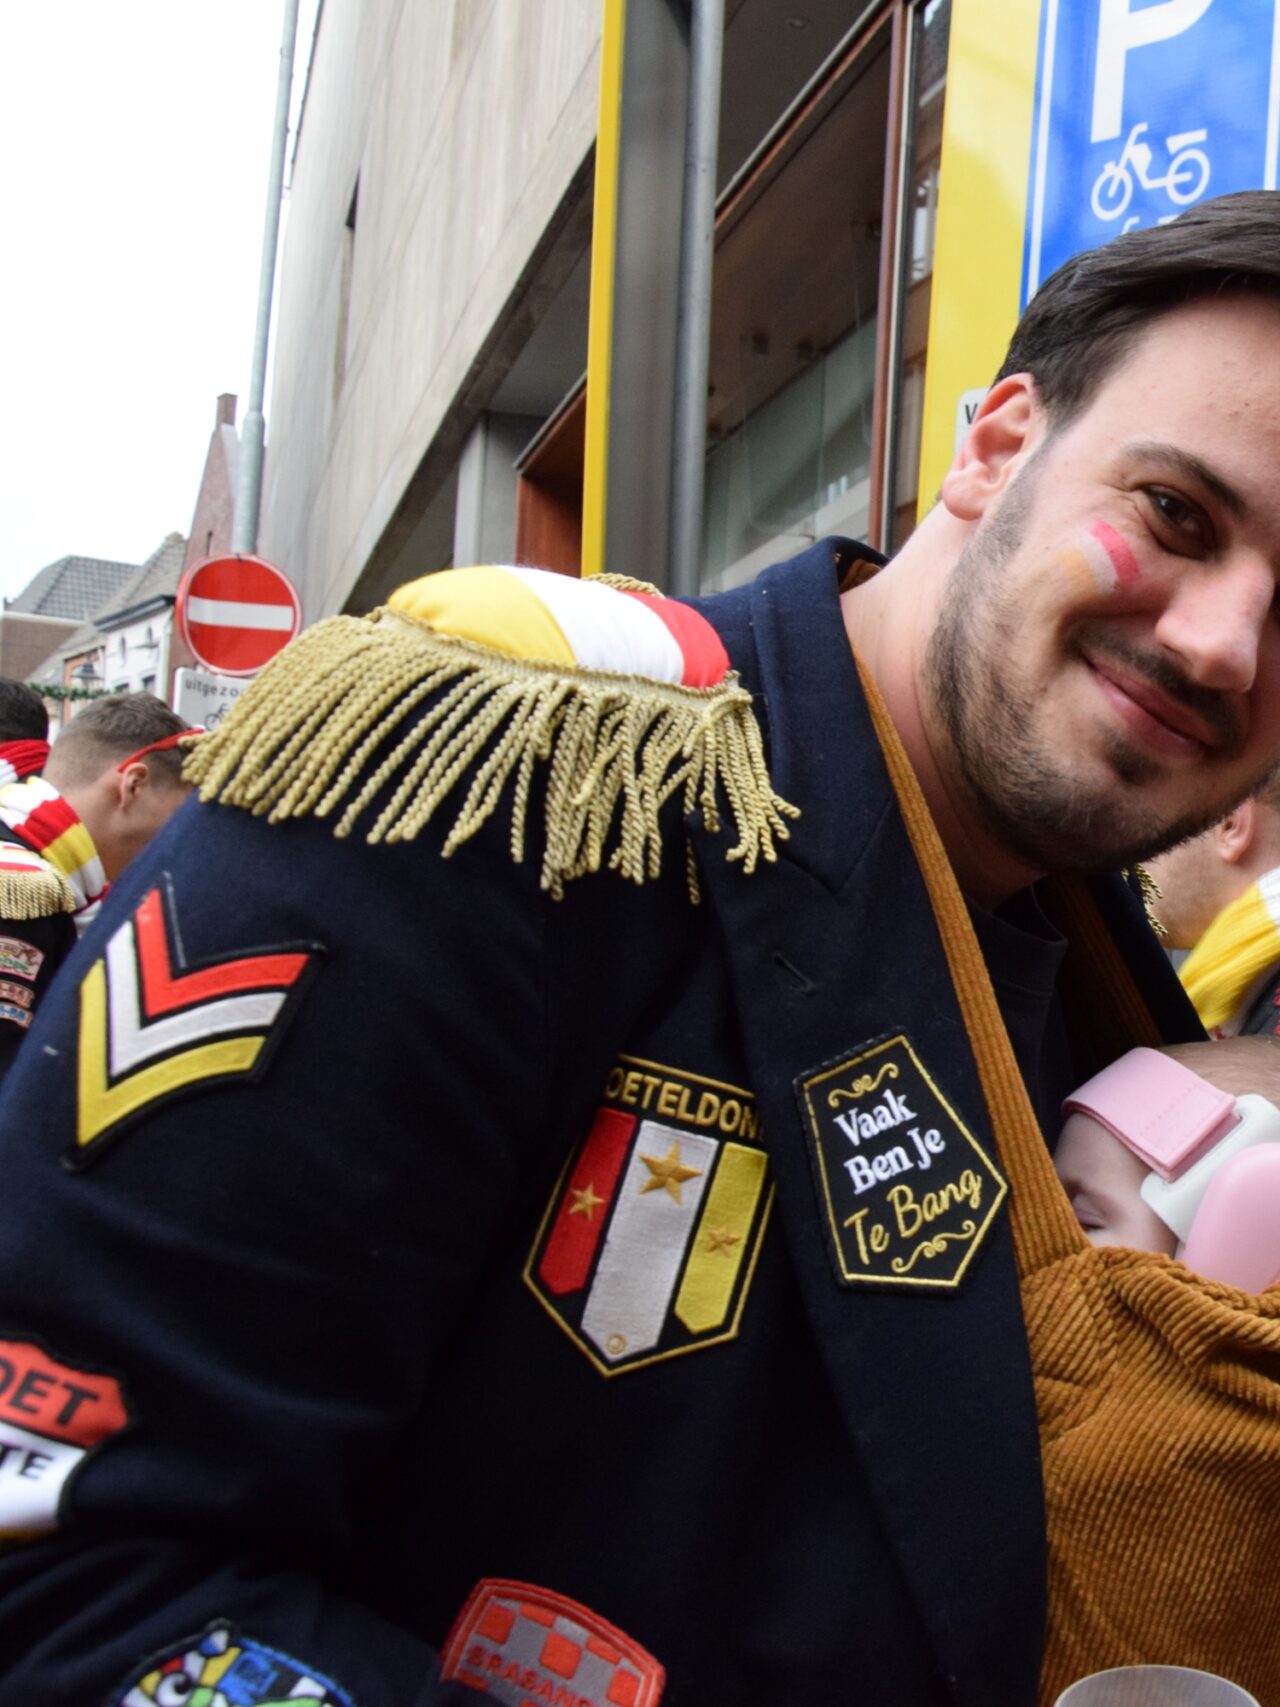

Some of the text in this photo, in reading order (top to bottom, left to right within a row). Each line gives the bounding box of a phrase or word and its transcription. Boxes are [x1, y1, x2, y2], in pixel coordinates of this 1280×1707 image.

[185, 679, 243, 698] uitgezo
[832, 1088, 917, 1147] Vaak
[843, 1126, 947, 1196] Ben Je
[842, 1168, 983, 1266] Te Bang
